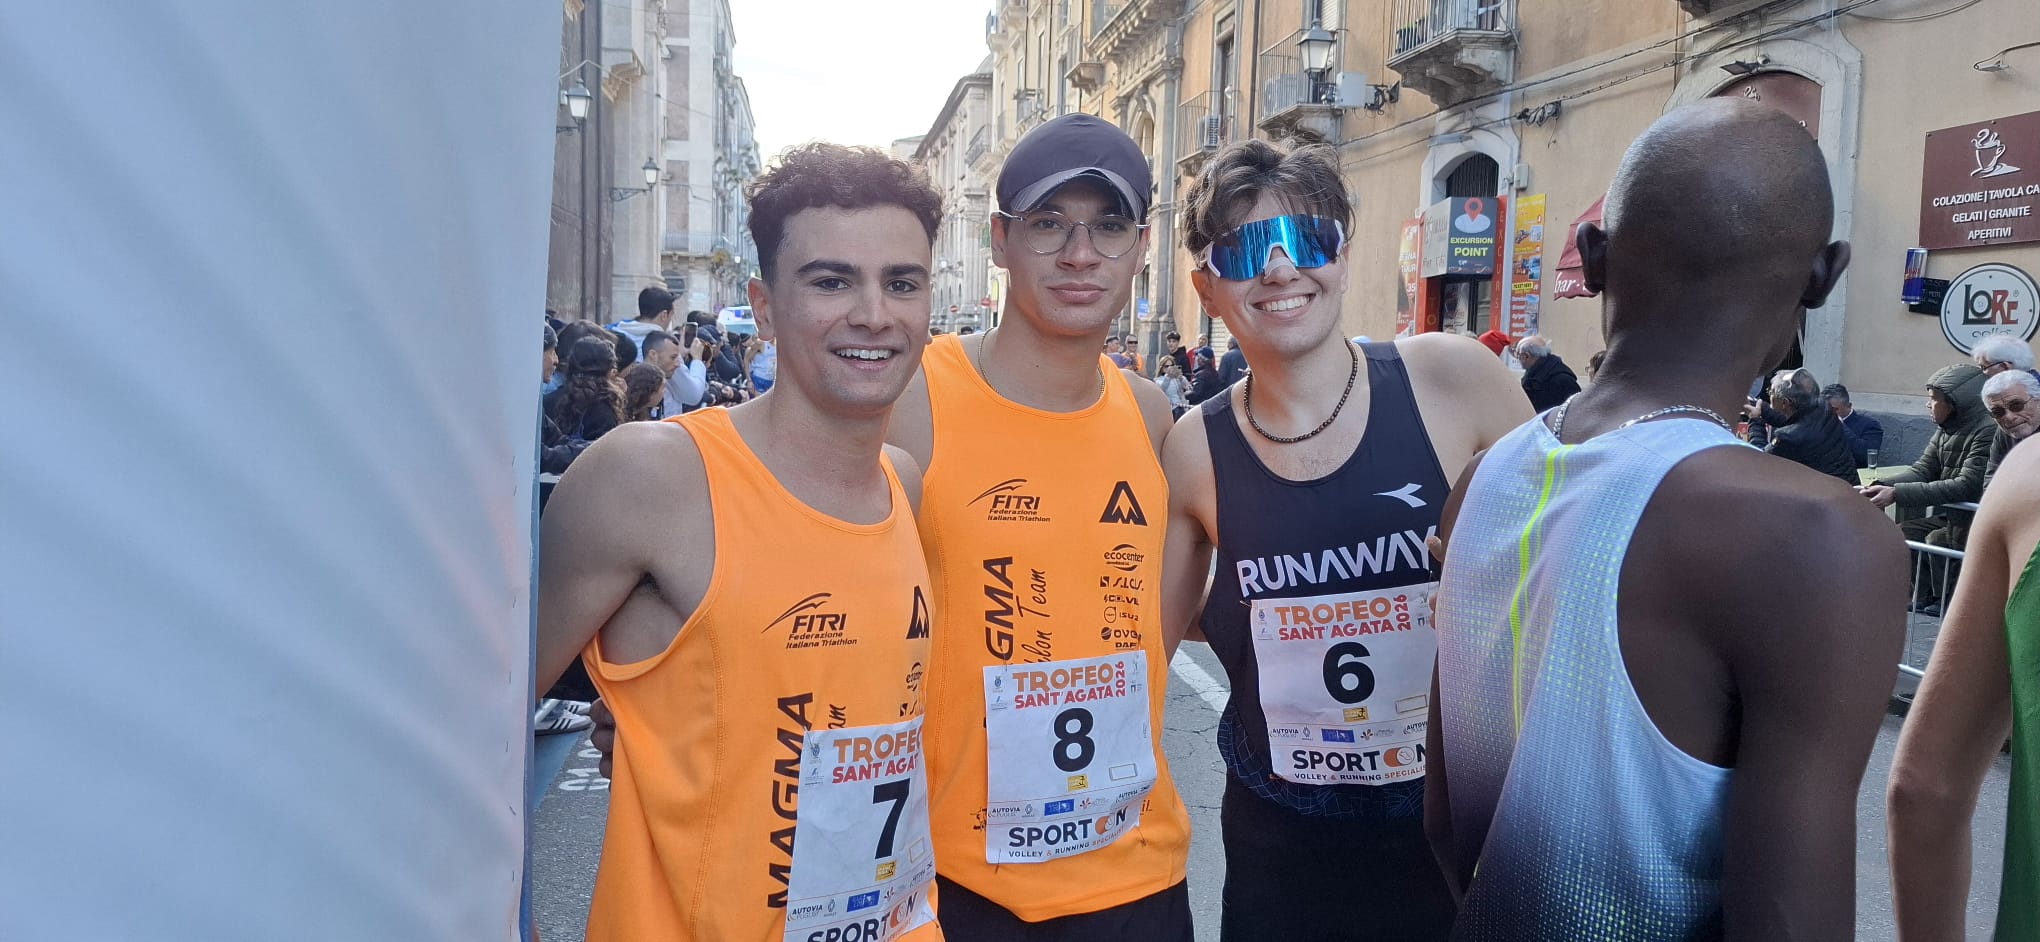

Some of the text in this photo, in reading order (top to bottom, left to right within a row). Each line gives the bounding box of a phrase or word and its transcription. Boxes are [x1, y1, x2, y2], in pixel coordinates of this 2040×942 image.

[1933, 191, 1983, 207] COLAZIONE
[1988, 186, 2024, 200] TAVOLA
[1952, 205, 2031, 223] GELATI GRANITE
[1967, 226, 2012, 240] APERITIVI
[1454, 247, 1488, 256] POINT
[992, 495, 1040, 510] FITRI
[1104, 551, 1144, 562] ecocenter
[1236, 525, 1436, 598] RUNAWAY
[792, 613, 846, 633] FITRI
[1274, 597, 1392, 627] TROFEO
[1393, 594, 1411, 632] 2026
[789, 631, 843, 640] Federazione
[1278, 619, 1395, 641] SANT'AGATA
[786, 639, 857, 649] Italiana Triathlon
[1012, 663, 1114, 693] TROFEO
[1115, 661, 1126, 697] 2026
[1322, 642, 1375, 704] 6
[1014, 685, 1114, 709] SANT'AGATA
[1052, 707, 1096, 772] 8
[1292, 750, 1380, 772] SPORT
[1340, 774, 1381, 782] RUNNING
[872, 778, 910, 859] 7
[1008, 818, 1092, 847] SPORT
[1055, 842, 1090, 855] RUNNING
[792, 904, 822, 915] AUTOVIA
